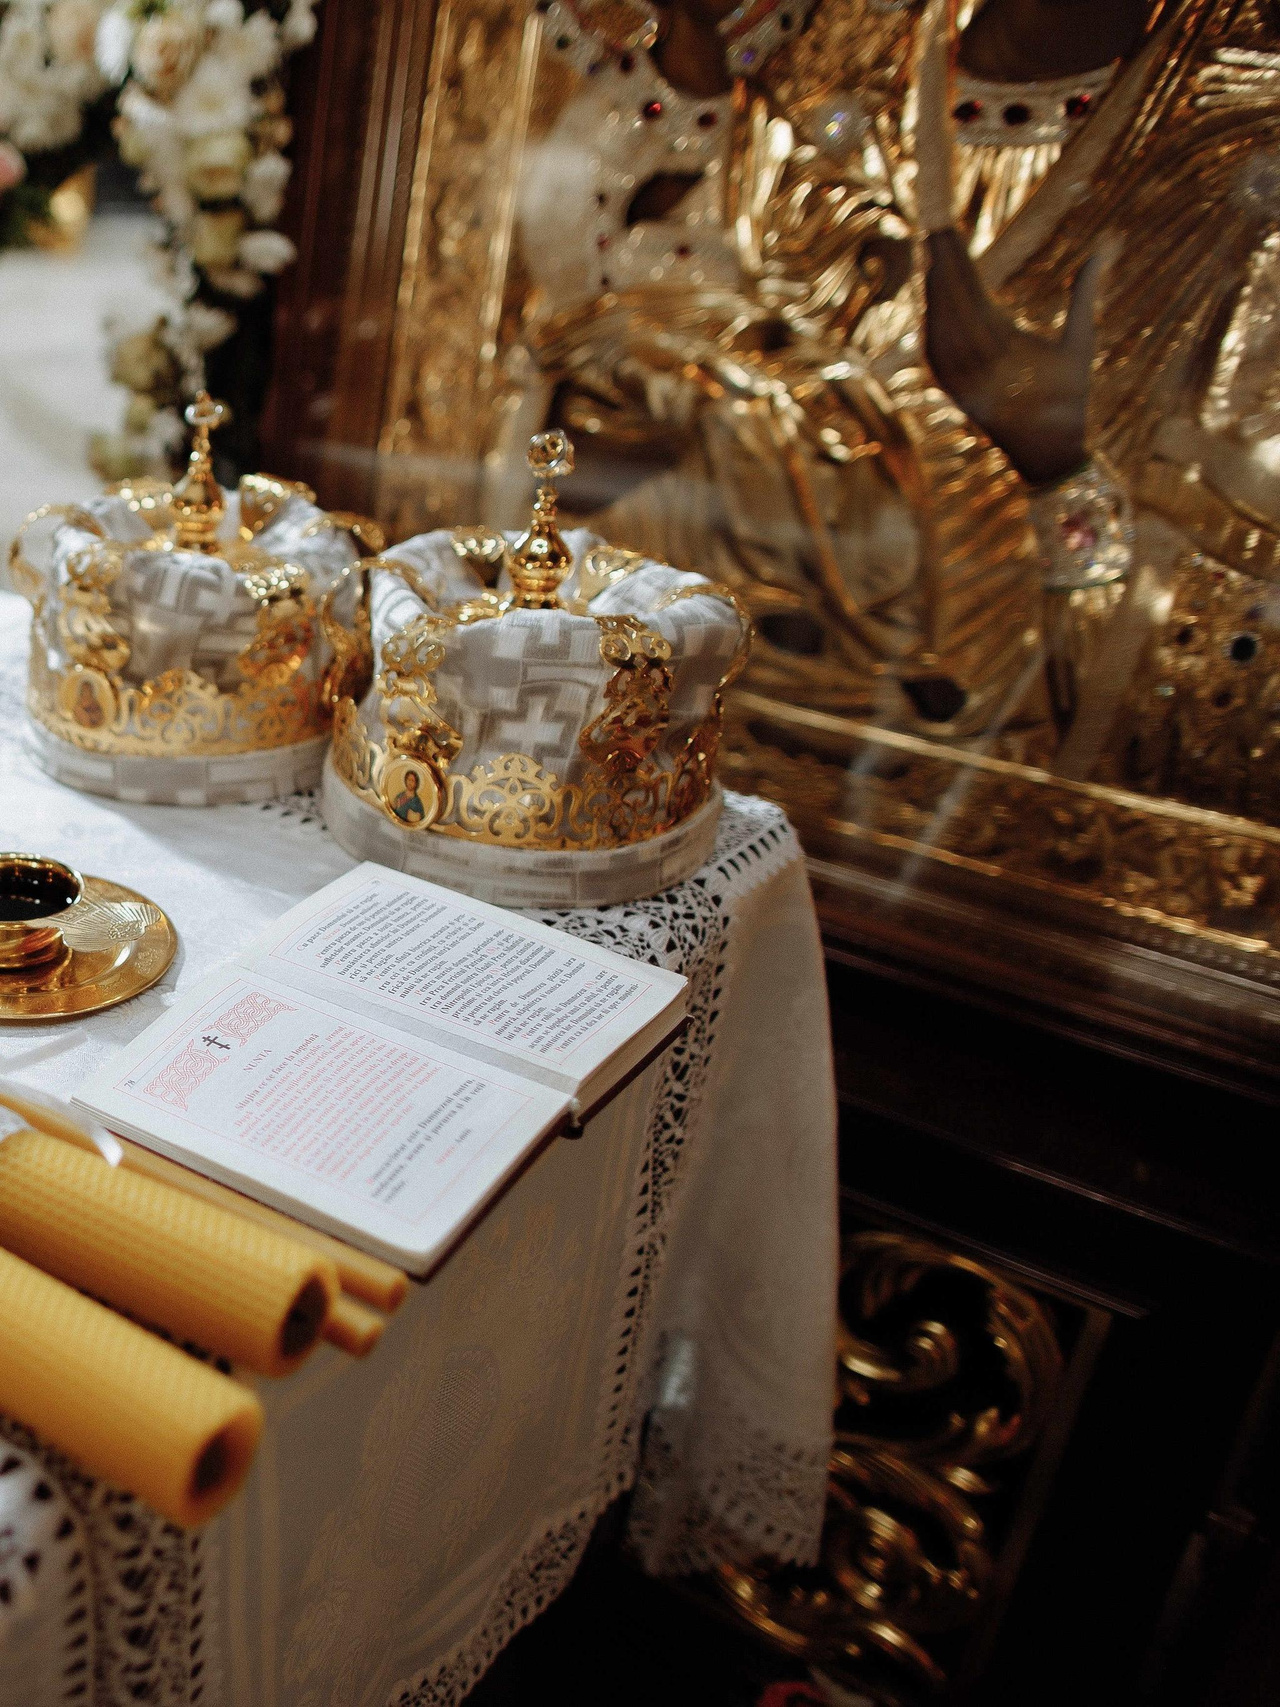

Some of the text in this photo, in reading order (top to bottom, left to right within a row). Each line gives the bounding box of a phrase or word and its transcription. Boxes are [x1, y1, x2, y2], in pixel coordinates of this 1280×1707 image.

[316, 941, 337, 958] Pentru
[333, 947, 357, 965] Pentru
[365, 947, 386, 965] pentru
[373, 962, 396, 980] Pentru
[387, 979, 405, 995] frică
[413, 978, 437, 996] Pentru
[488, 1008, 510, 1024] Pentru
[520, 1021, 543, 1038] Pentru
[242, 1048, 272, 1071] NUNTA
[234, 1088, 260, 1109] Slujba
[270, 1060, 289, 1075] face
[290, 1032, 319, 1055] logodnă
